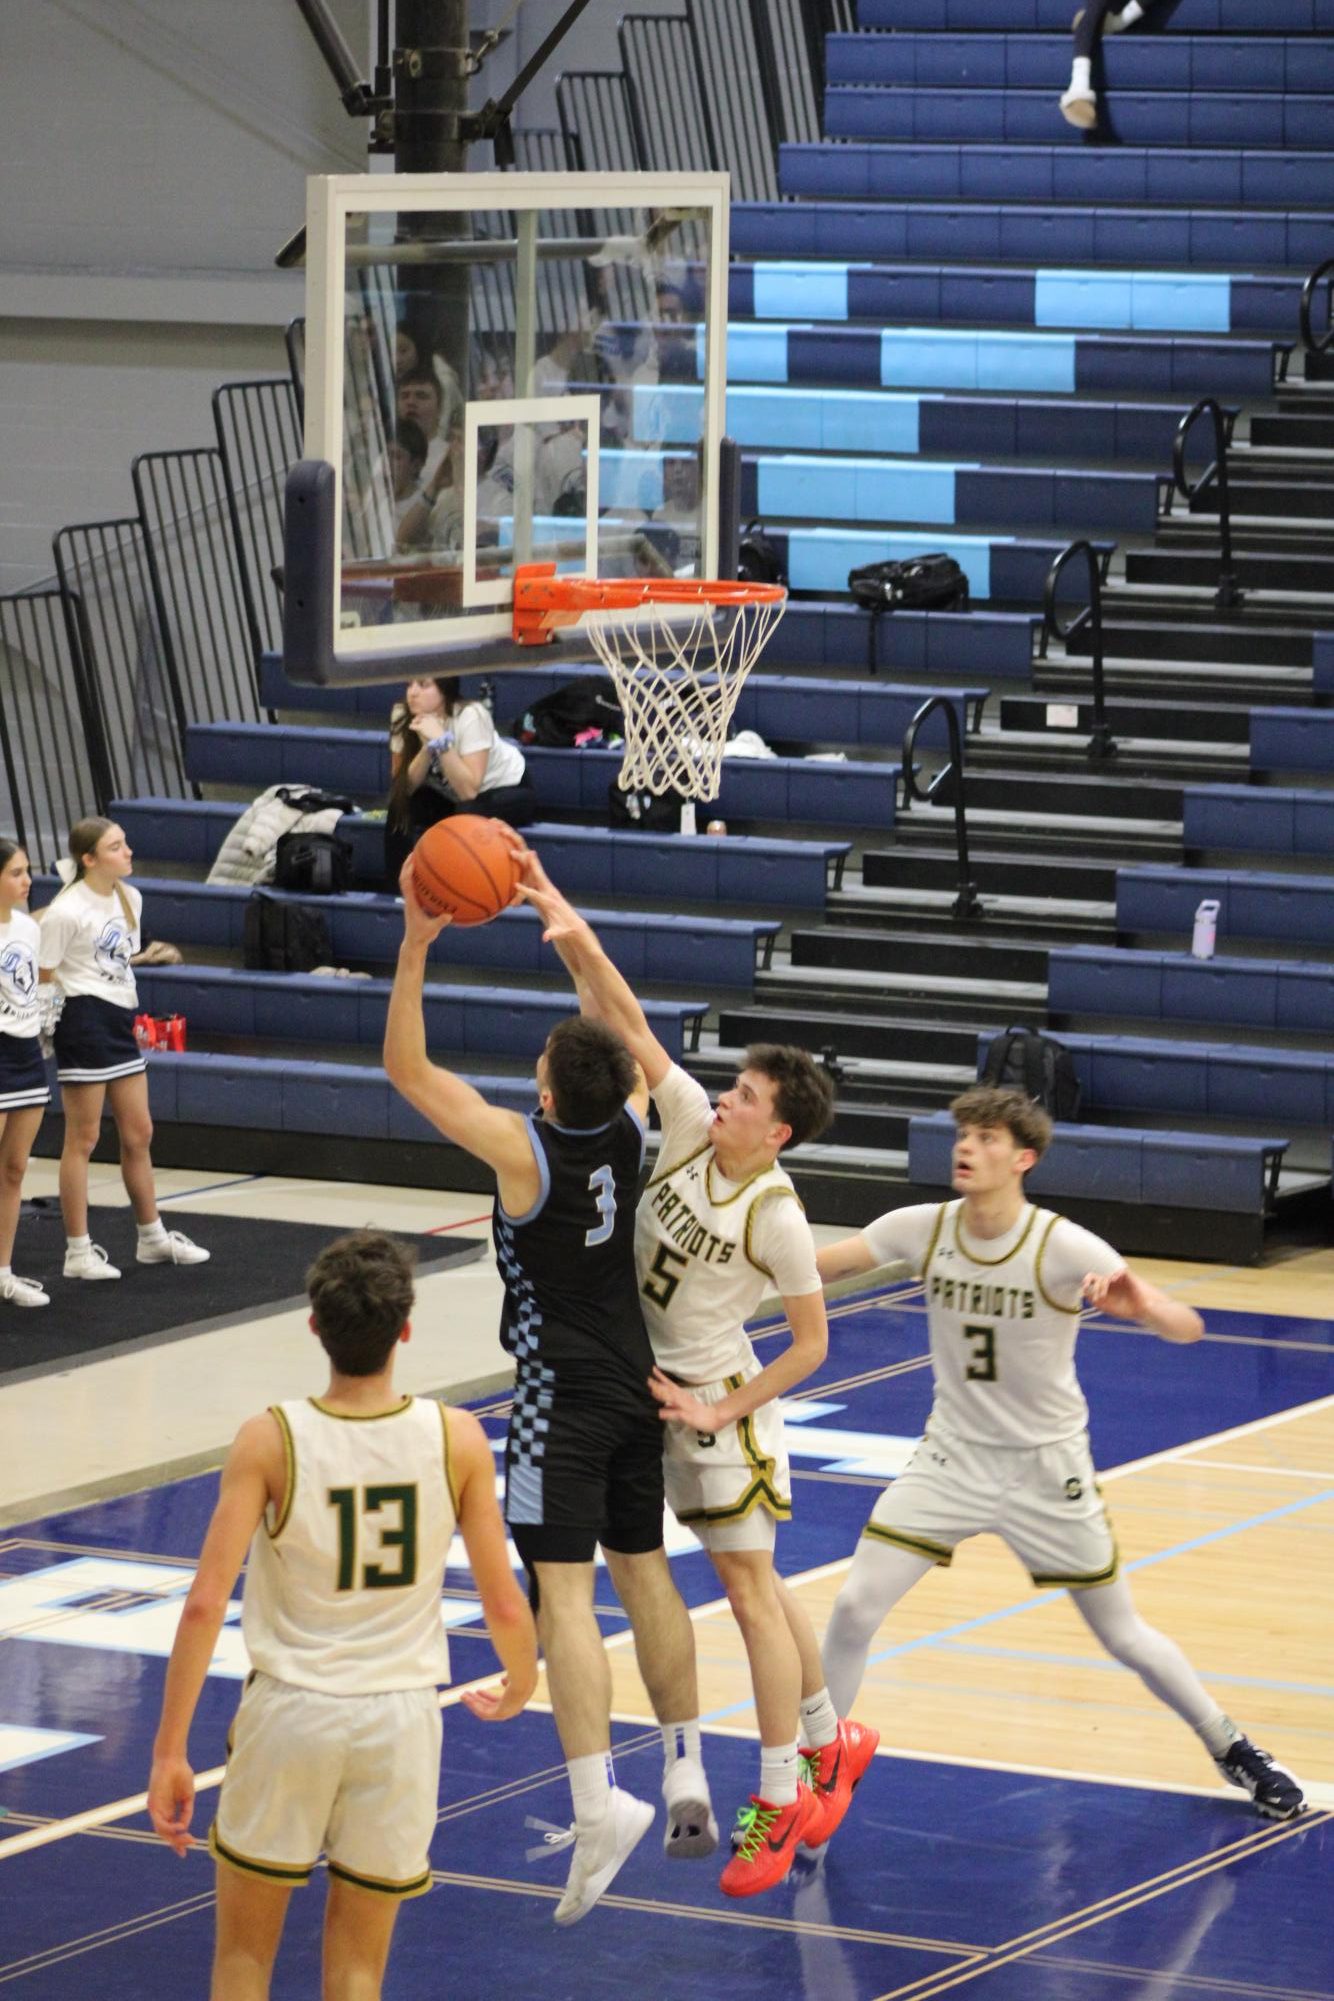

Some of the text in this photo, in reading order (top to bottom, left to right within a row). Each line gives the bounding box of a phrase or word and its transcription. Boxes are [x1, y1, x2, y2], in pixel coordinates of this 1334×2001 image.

[585, 1164, 617, 1247] 3
[650, 1181, 737, 1264] PATRIOTS
[642, 1240, 689, 1312] 5
[930, 1277, 1034, 1319] PATRIOTS
[963, 1324, 997, 1382] 3
[327, 1481, 418, 1592] 13
